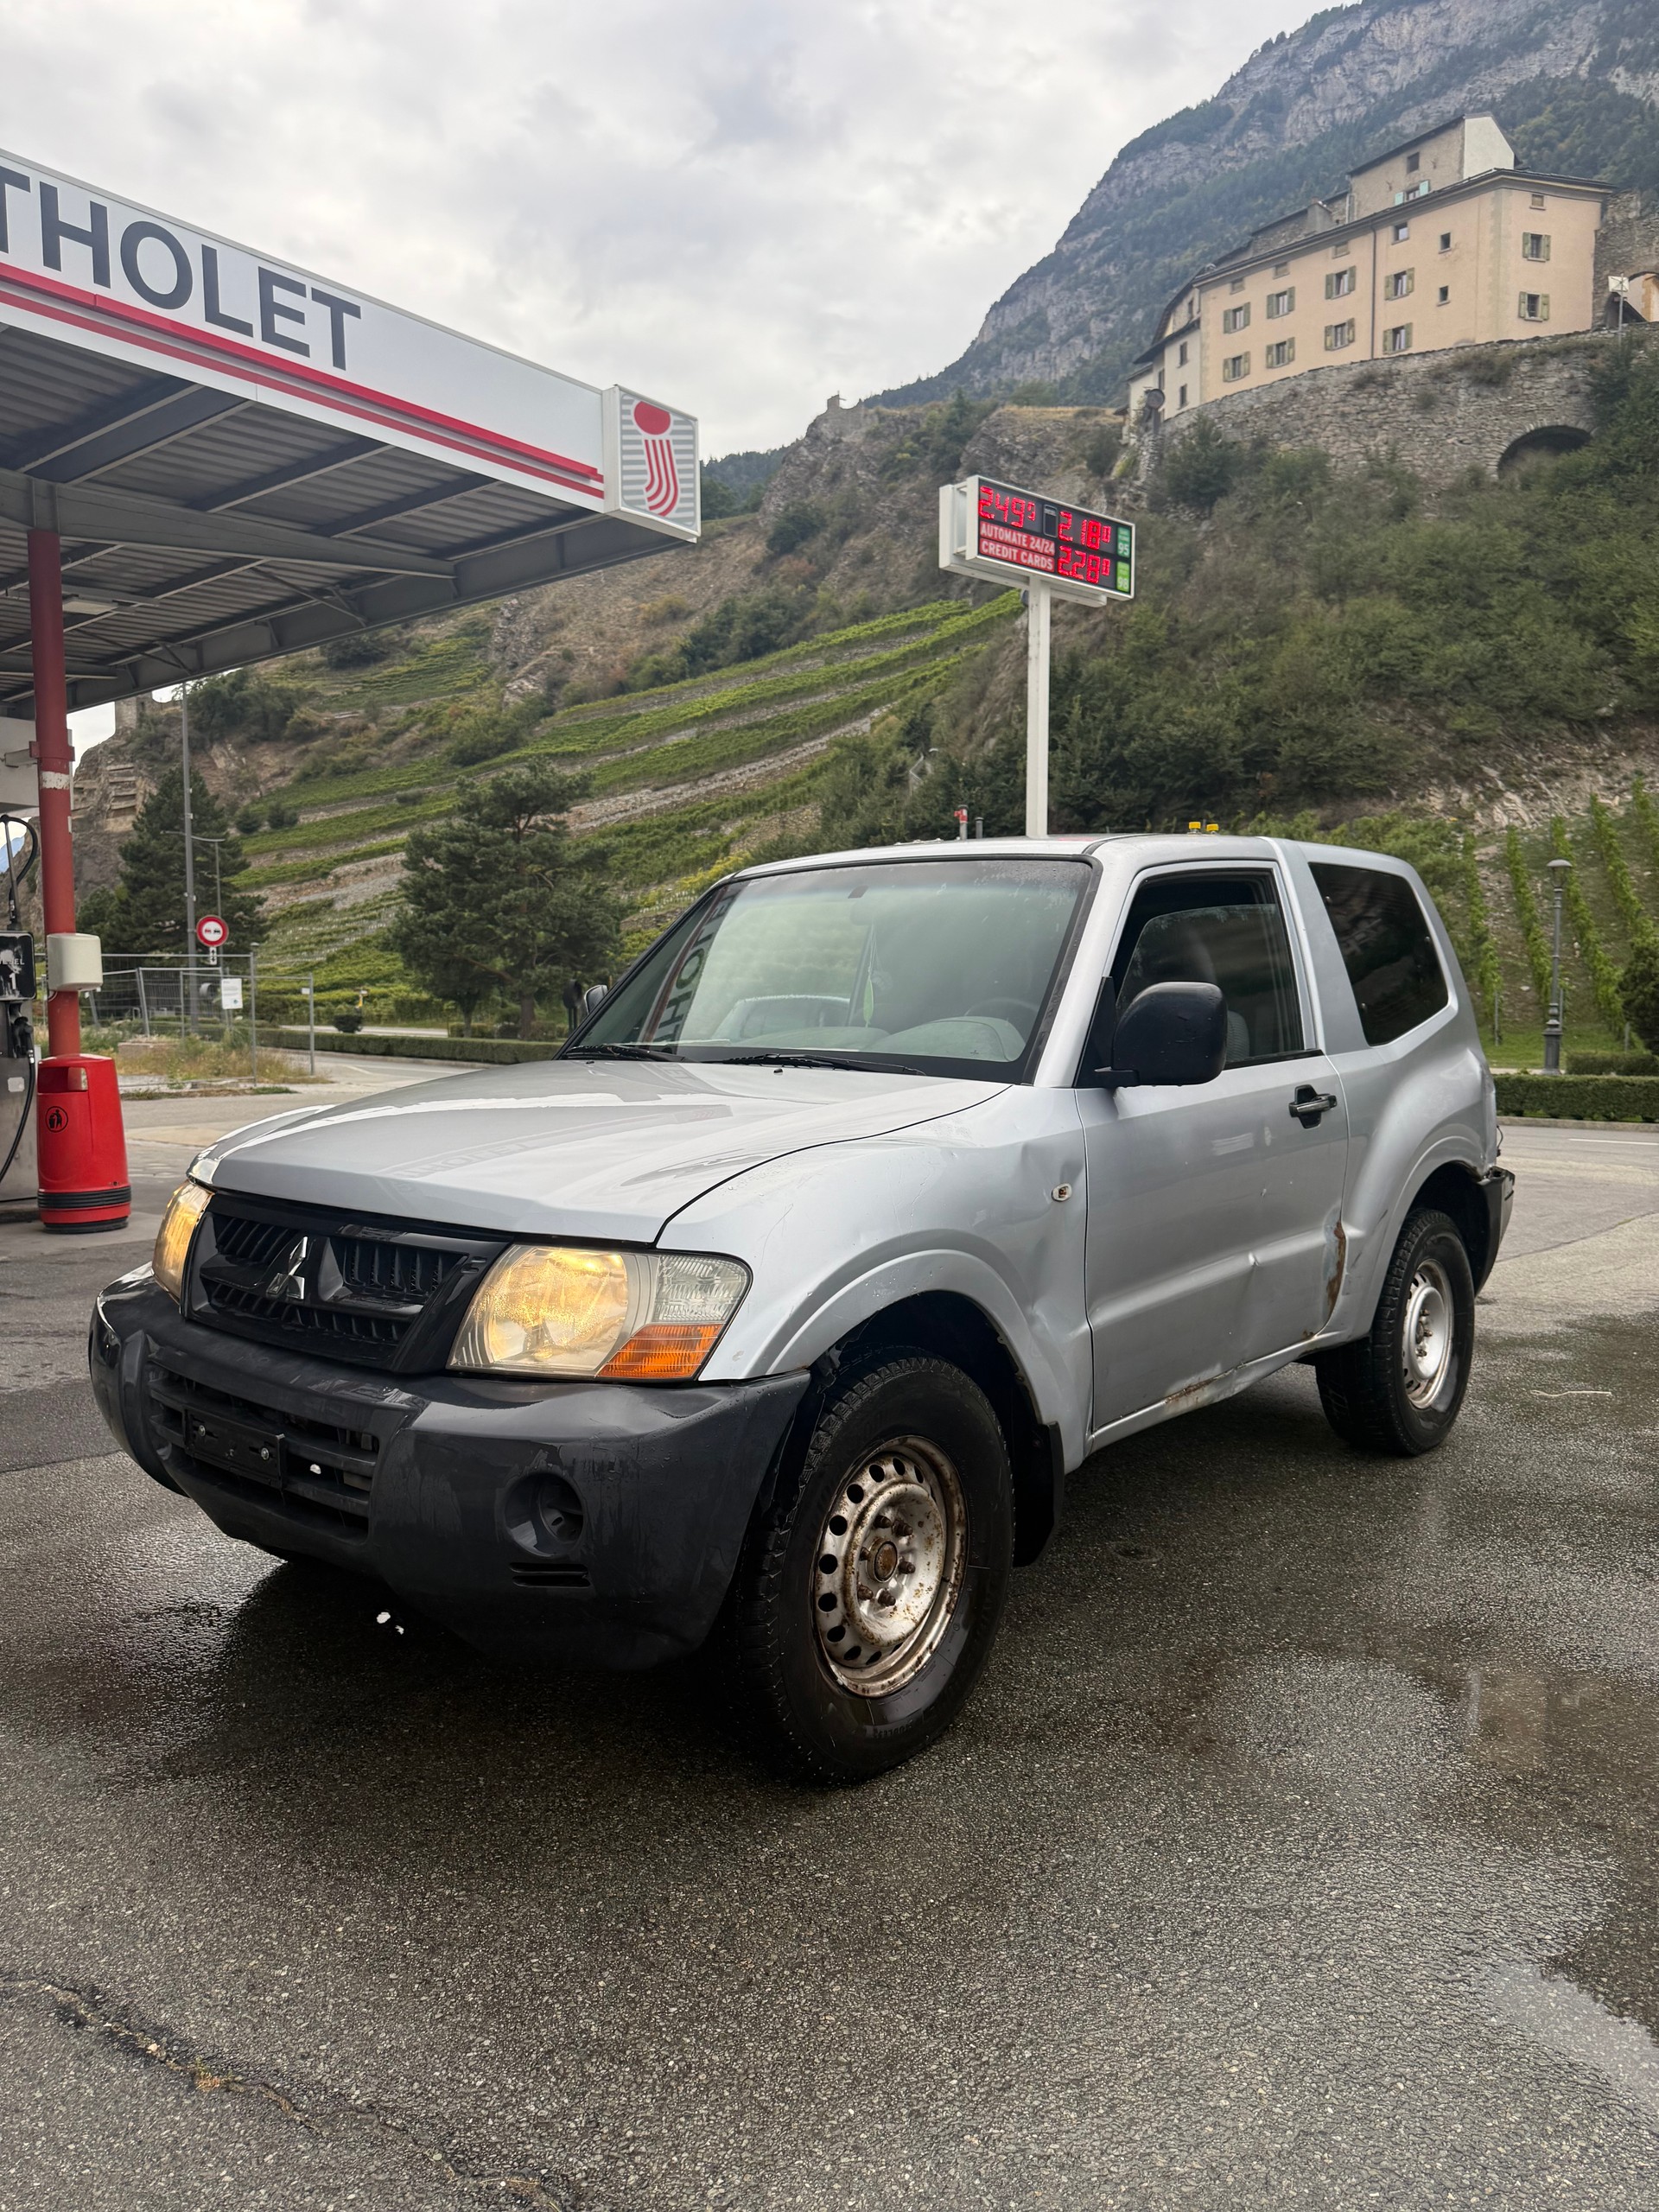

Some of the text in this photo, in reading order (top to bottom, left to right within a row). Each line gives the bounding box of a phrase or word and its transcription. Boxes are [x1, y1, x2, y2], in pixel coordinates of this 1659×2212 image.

[981, 524, 1055, 555] AUTOMATE 24/24
[1118, 542, 1130, 556] 95
[982, 541, 1053, 571] CREDIT CARDS
[9, 973, 17, 990] 1
